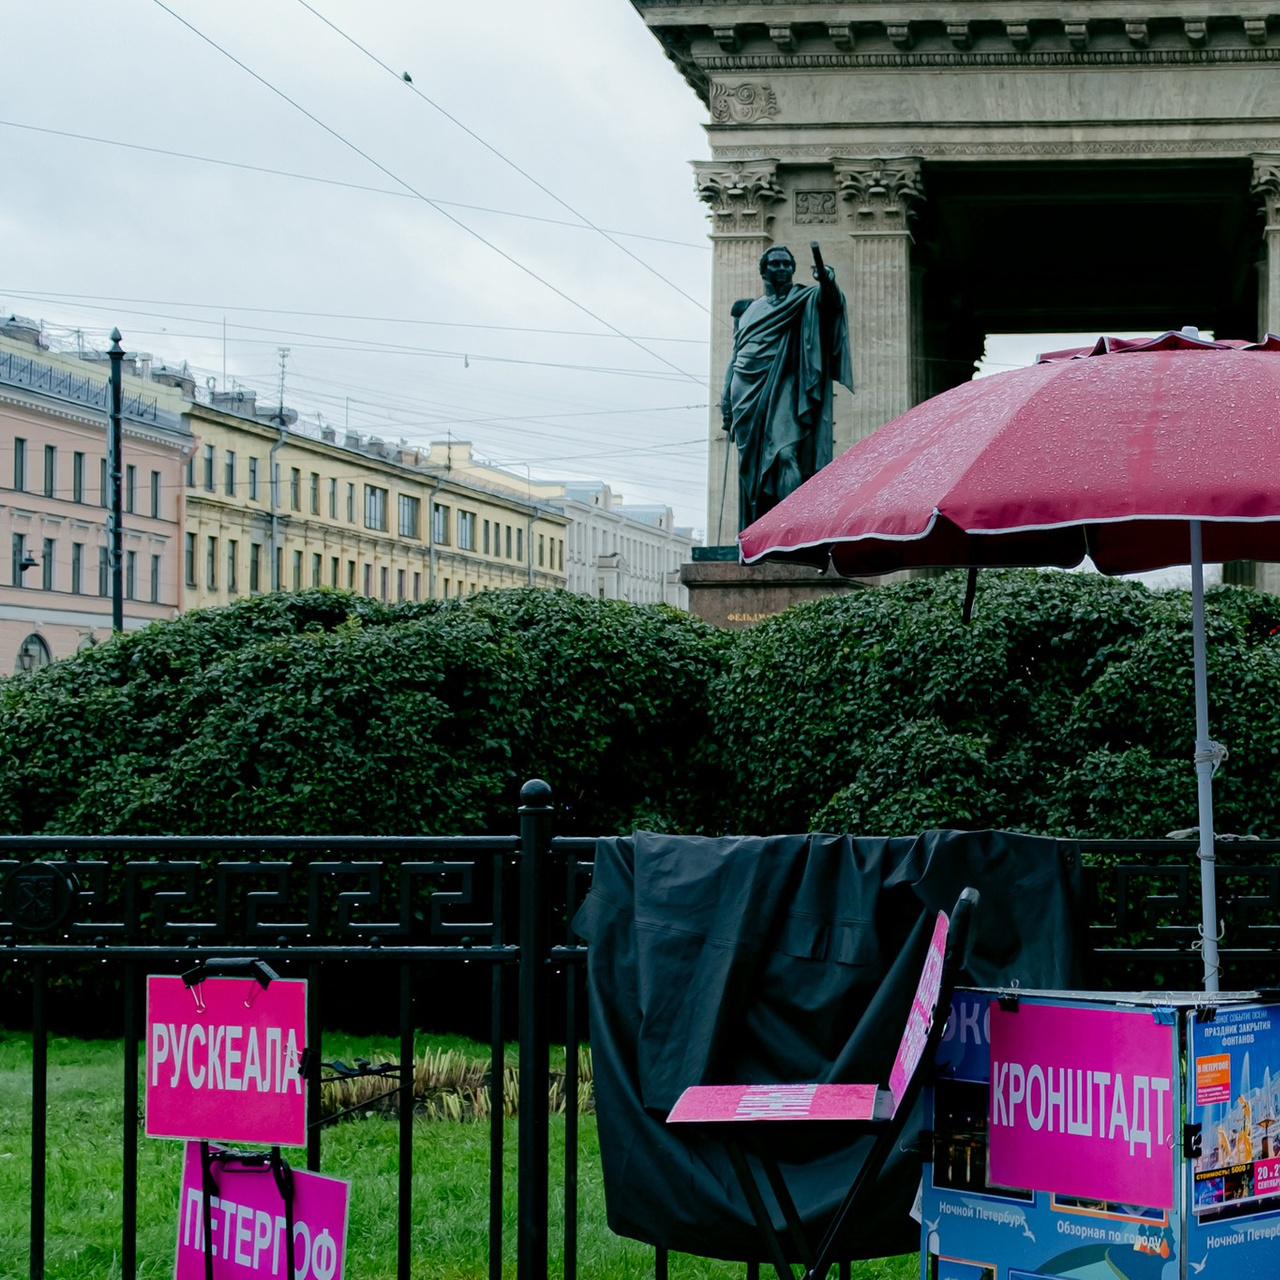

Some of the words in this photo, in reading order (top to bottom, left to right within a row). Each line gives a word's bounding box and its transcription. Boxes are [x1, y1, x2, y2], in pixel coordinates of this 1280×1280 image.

[1204, 1025, 1238, 1038] ПРАЗДНИК
[1239, 1020, 1272, 1034] ЗАКРЫТИЯ
[1221, 1033, 1255, 1047] ФОНТАНОВ
[152, 1023, 302, 1095] РУСКЕАЛА
[993, 1061, 1170, 1158] КРОНШТАДТ
[1257, 1166, 1268, 1180] 20
[939, 1200, 975, 1220] Ночной
[1057, 1220, 1106, 1241] Обзорная
[1108, 1230, 1121, 1241] по
[1124, 1233, 1161, 1253] городу
[1206, 1231, 1245, 1250] Ночной
